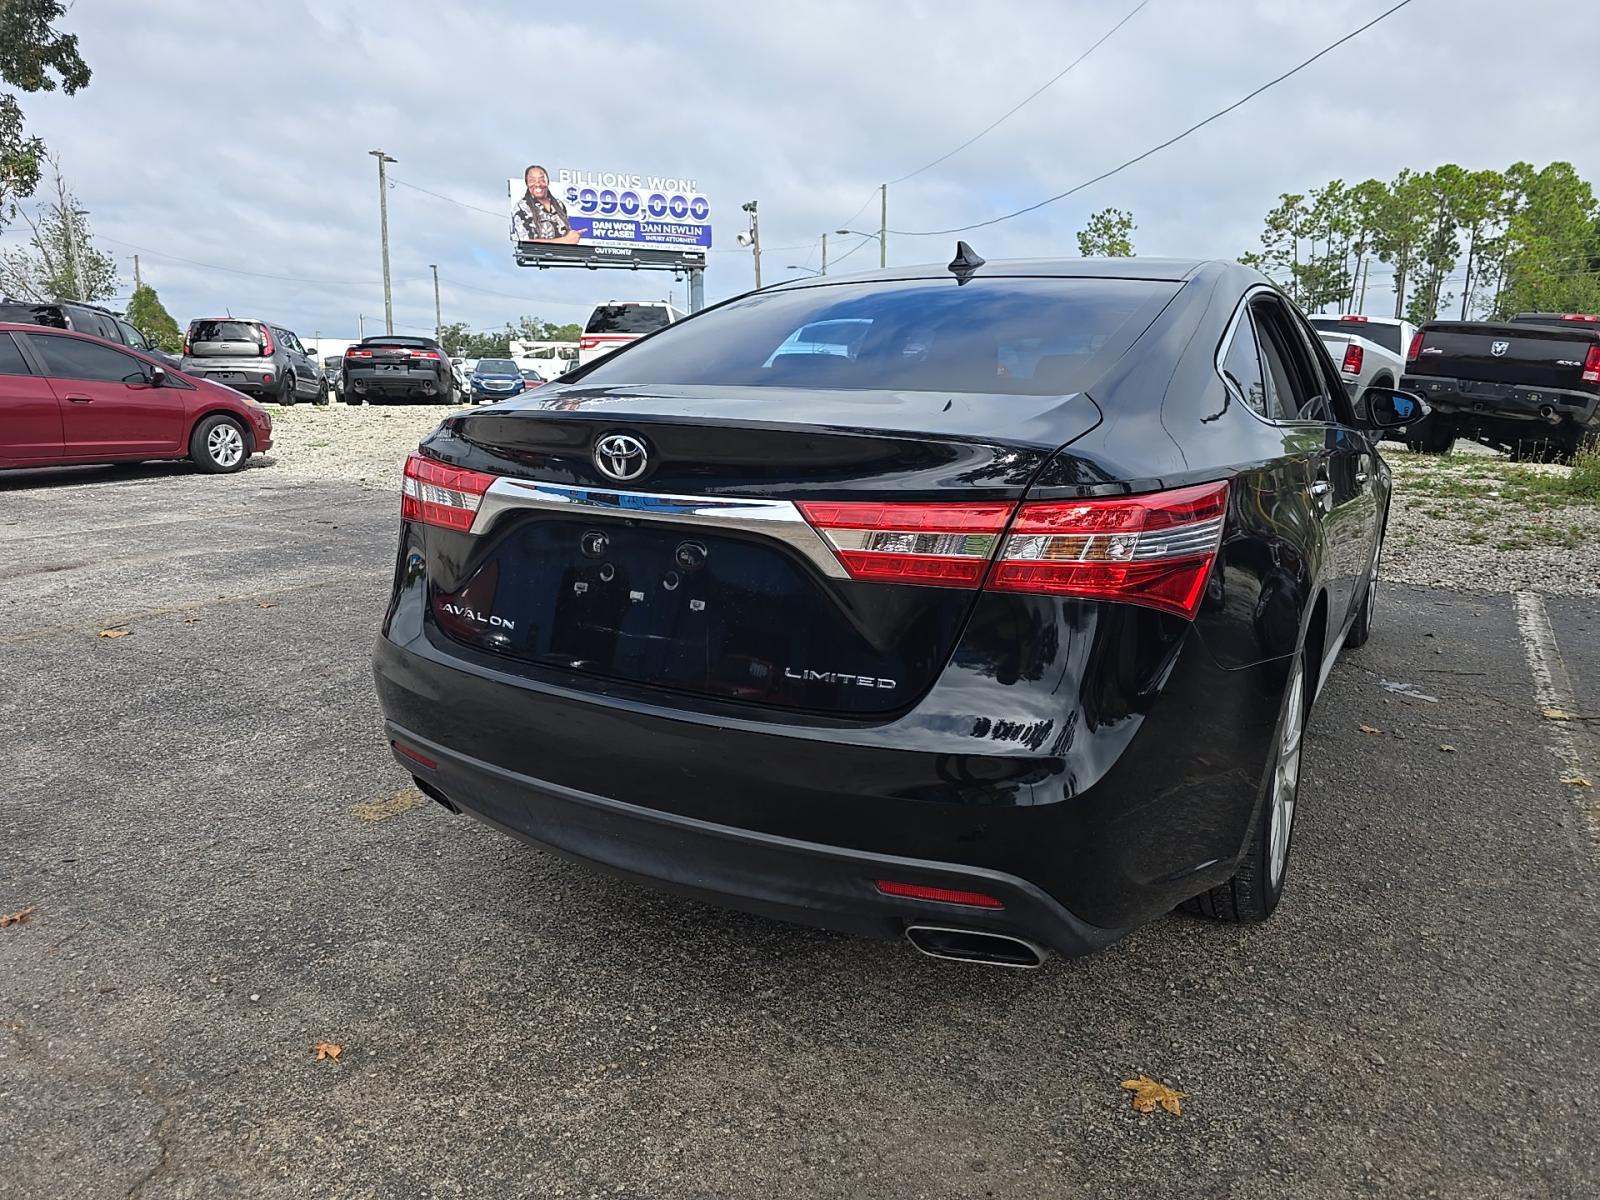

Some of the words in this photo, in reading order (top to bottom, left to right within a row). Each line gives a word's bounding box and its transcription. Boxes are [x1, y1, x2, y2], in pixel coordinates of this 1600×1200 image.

[559, 169, 641, 189] BILLIONS
[647, 176, 697, 193] WON!
[566, 187, 710, 221] $990,000
[592, 221, 612, 229] DAN
[613, 222, 635, 231] WON
[592, 229, 606, 237] MY
[640, 223, 662, 233] DAN
[663, 225, 703, 235] NEWLIN
[442, 603, 515, 630] AVALON
[785, 667, 897, 688] LIMITED
